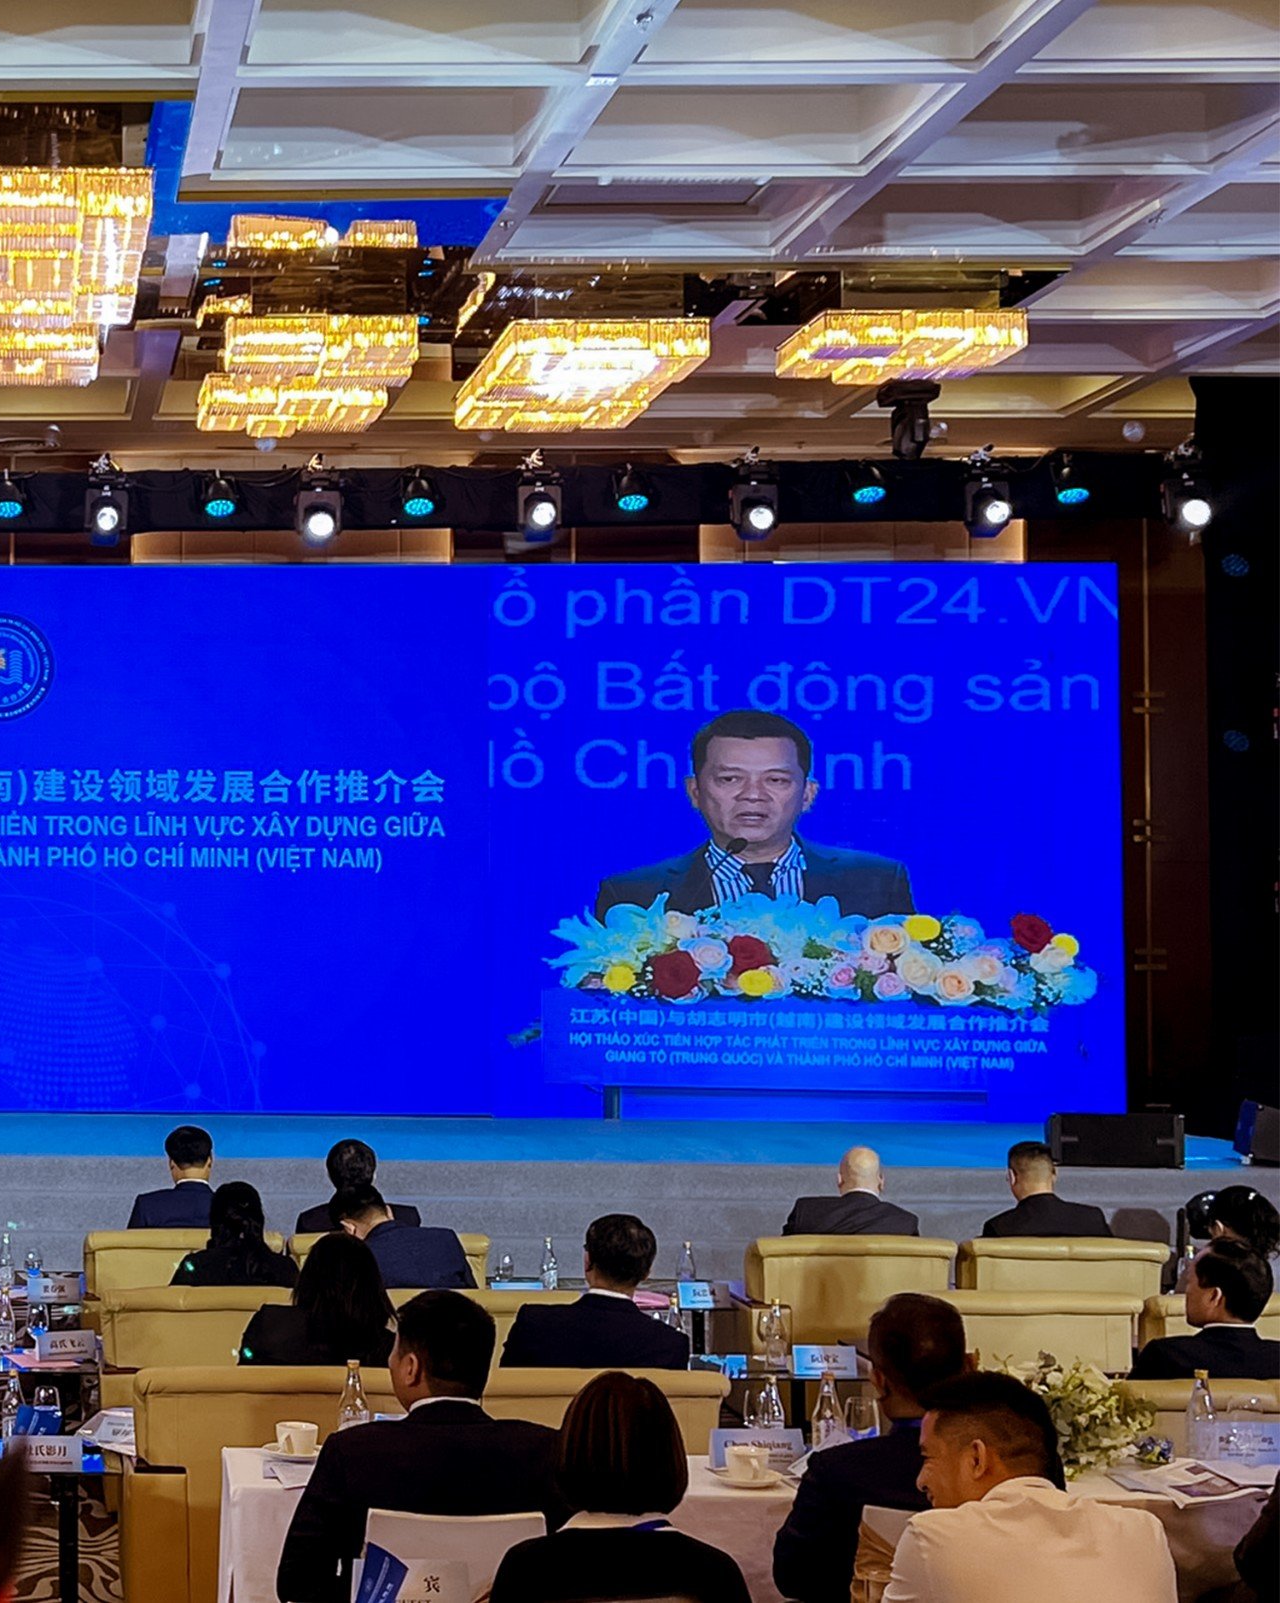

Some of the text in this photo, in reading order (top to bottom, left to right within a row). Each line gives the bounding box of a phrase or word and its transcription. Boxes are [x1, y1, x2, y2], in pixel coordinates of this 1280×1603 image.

[492, 565, 1118, 638] ổ phần DT24.VN
[597, 649, 720, 712] Bất
[747, 660, 934, 724] động
[963, 658, 1100, 712] sản
[489, 727, 912, 790] ồ Ch nh
[43, 815, 128, 837] TRONG
[134, 810, 187, 837] LĨNH
[193, 815, 246, 841] VỰC
[251, 810, 301, 837] XÂY
[306, 815, 378, 842] DỰNG
[383, 811, 446, 838] GIỮA
[46, 841, 97, 868] PHỐ
[144, 841, 184, 868] CHÍ
[190, 847, 249, 868] MINH
[256, 844, 316, 873] (VIỆT
[321, 847, 383, 874] NAM)
[605, 1049, 646, 1063] GIANG
[669, 1050, 719, 1066] (TRUNG
[910, 1055, 943, 1069] MINH
[832, 1036, 877, 1050] TRONG
